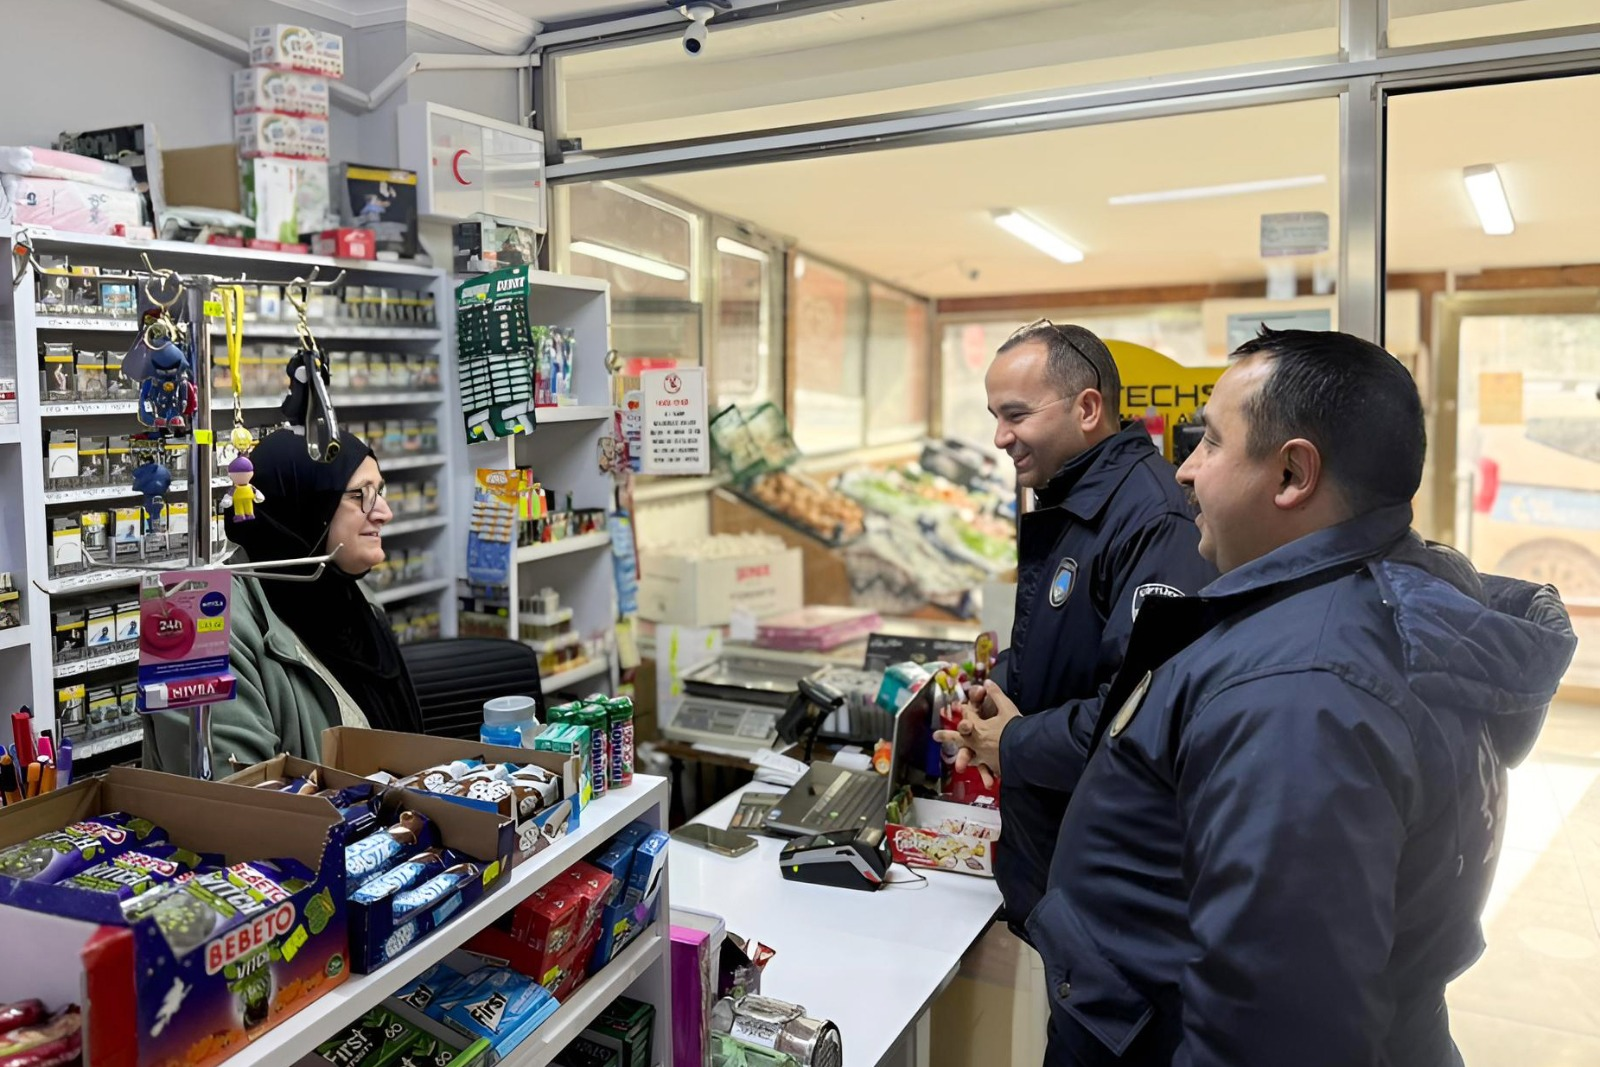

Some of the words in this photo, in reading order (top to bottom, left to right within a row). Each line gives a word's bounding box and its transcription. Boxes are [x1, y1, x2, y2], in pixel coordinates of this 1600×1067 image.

[208, 905, 293, 971] BEBETO
[470, 992, 507, 1027] First
[322, 1028, 369, 1062] First
